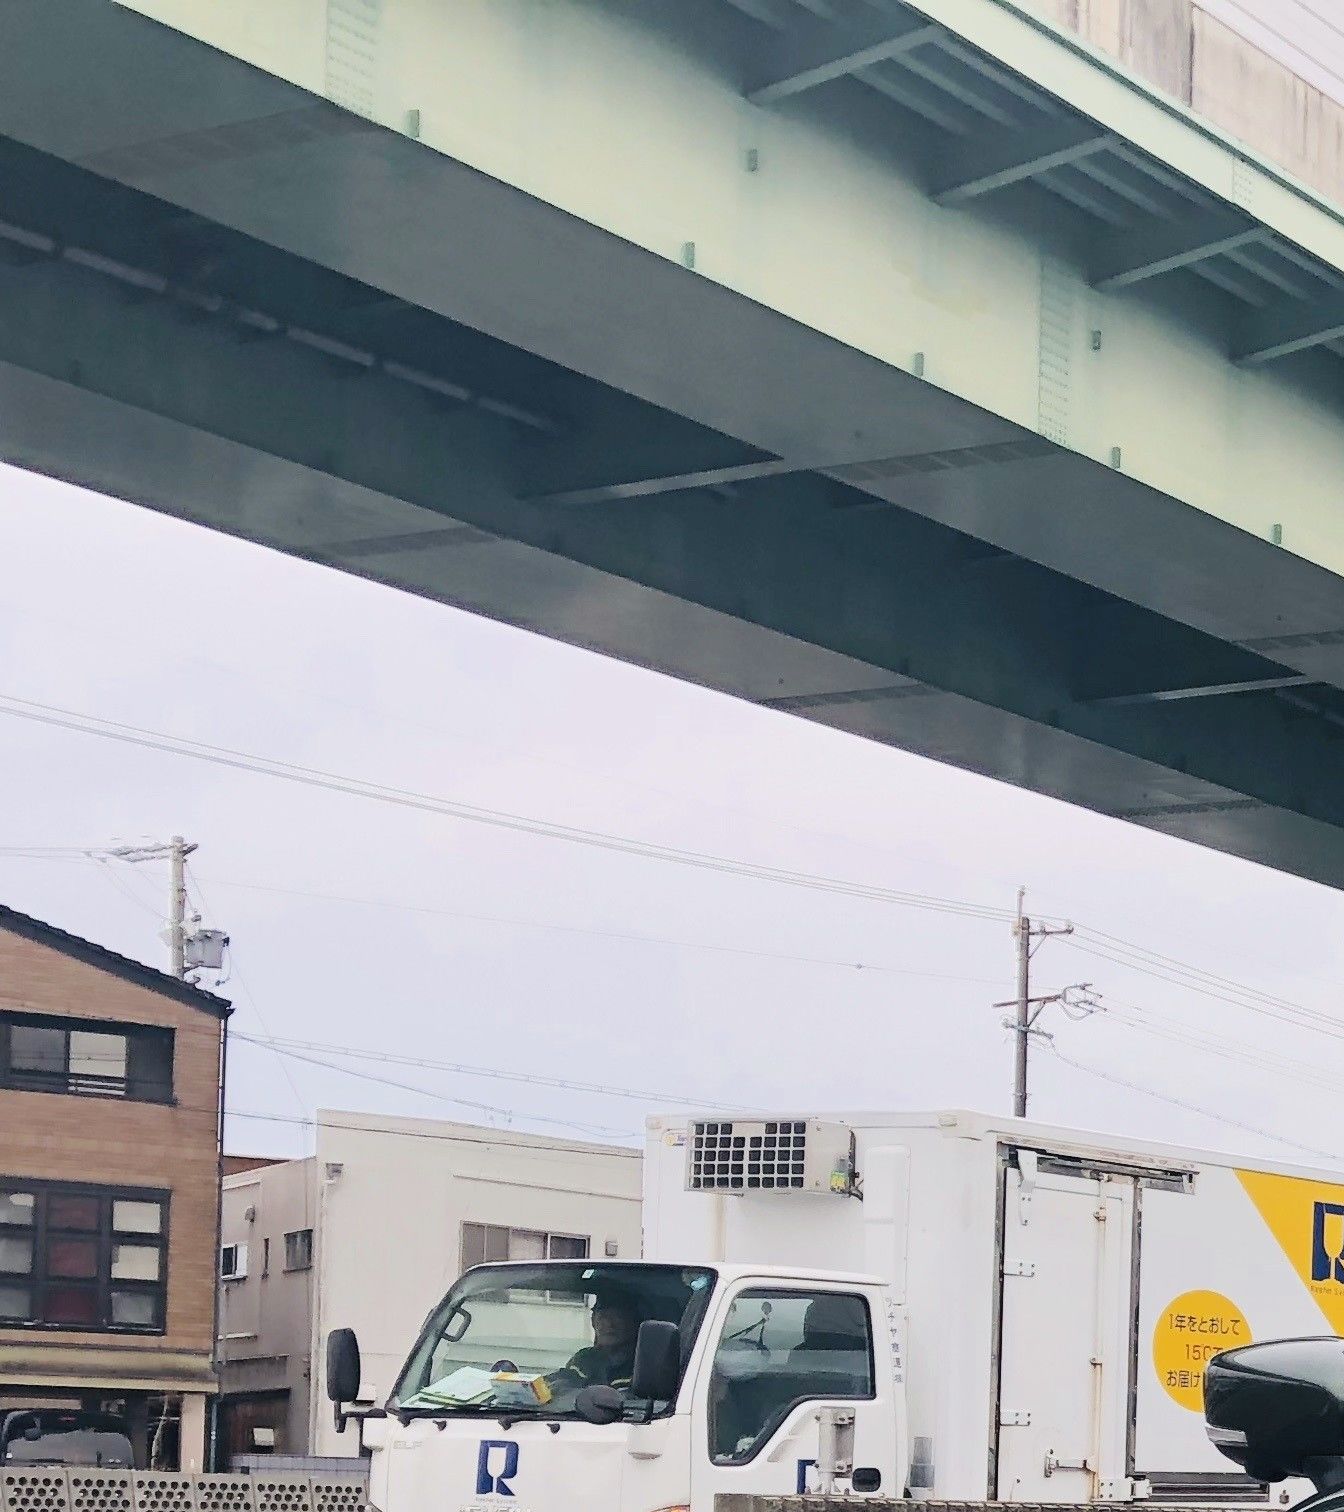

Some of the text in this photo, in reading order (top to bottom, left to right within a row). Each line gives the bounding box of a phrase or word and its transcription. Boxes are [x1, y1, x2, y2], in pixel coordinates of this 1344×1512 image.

[1168, 1313, 1241, 1336] 1年をとおして
